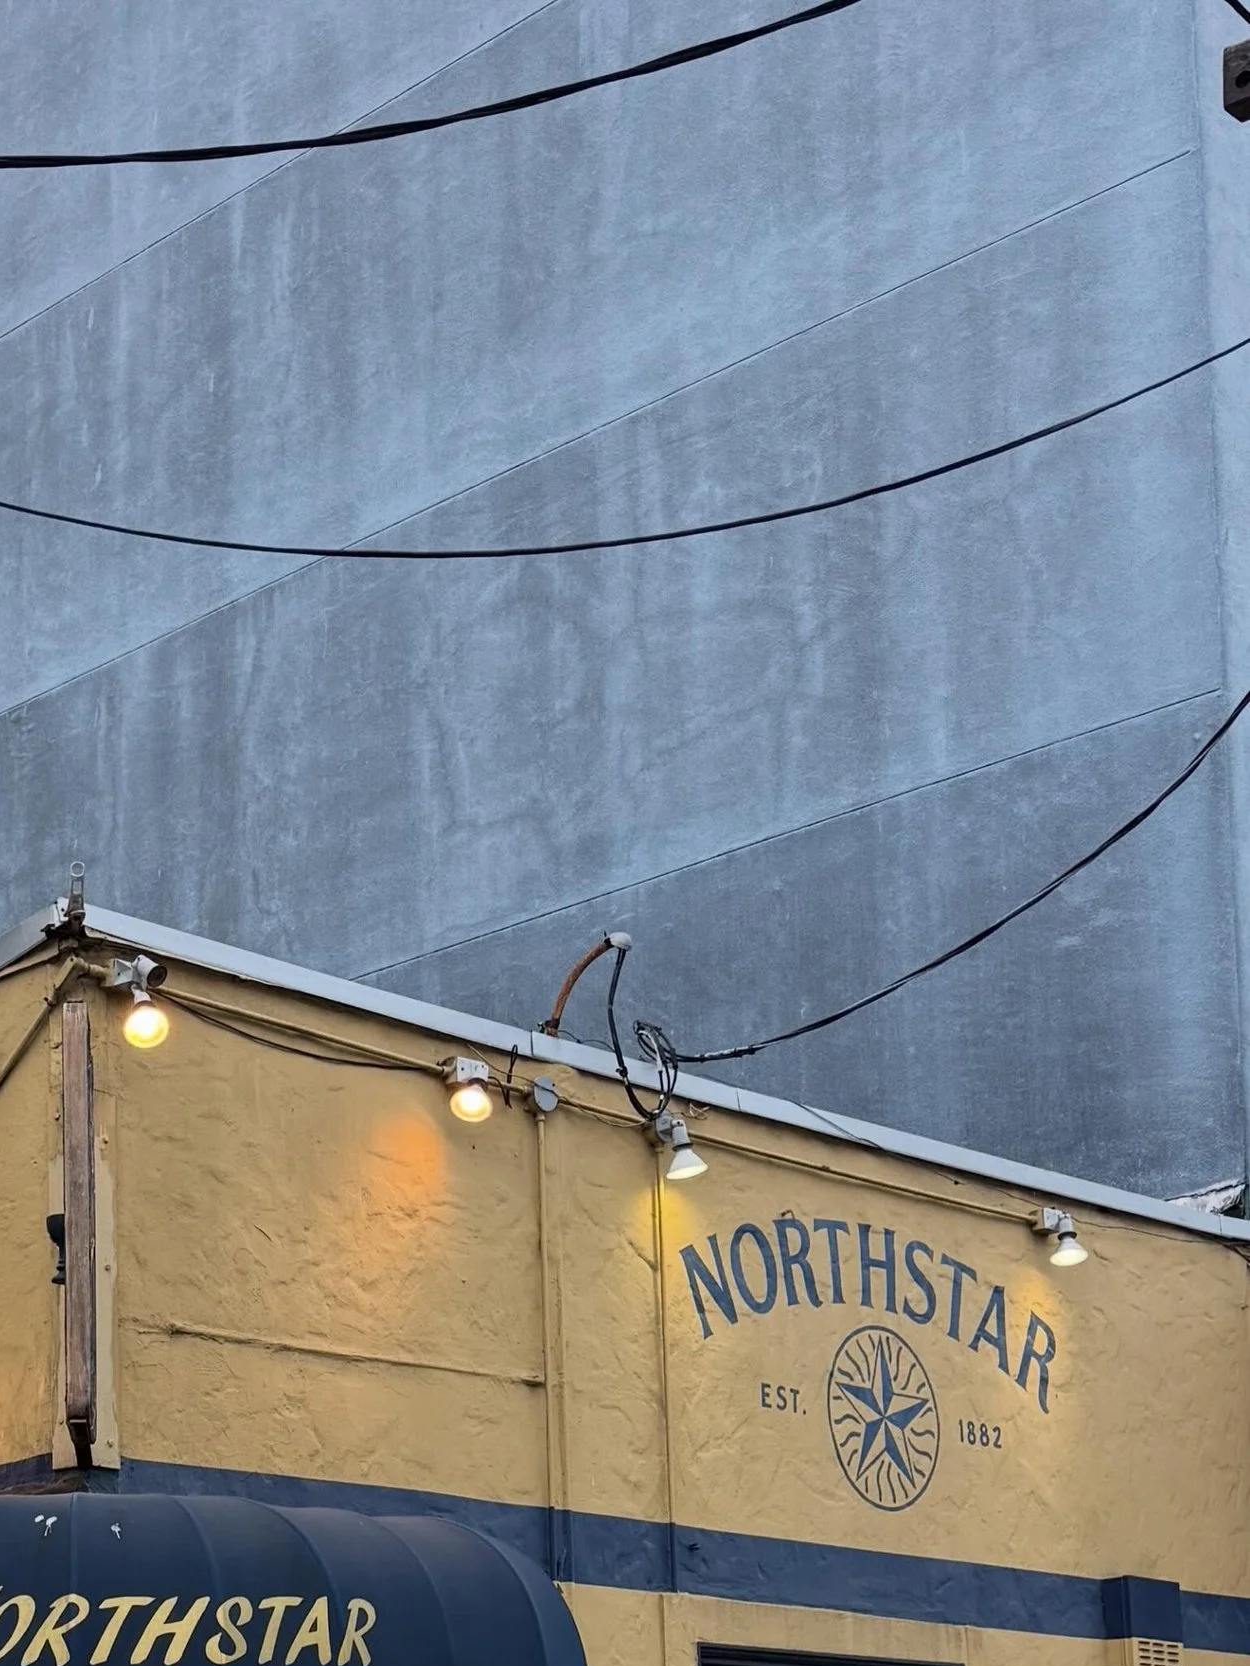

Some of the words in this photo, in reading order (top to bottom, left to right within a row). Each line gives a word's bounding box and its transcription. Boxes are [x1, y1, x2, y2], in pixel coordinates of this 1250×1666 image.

[678, 1217, 1057, 1415] NORTHSTAR
[760, 1381, 807, 1416] EST.
[957, 1419, 1003, 1450] 1882
